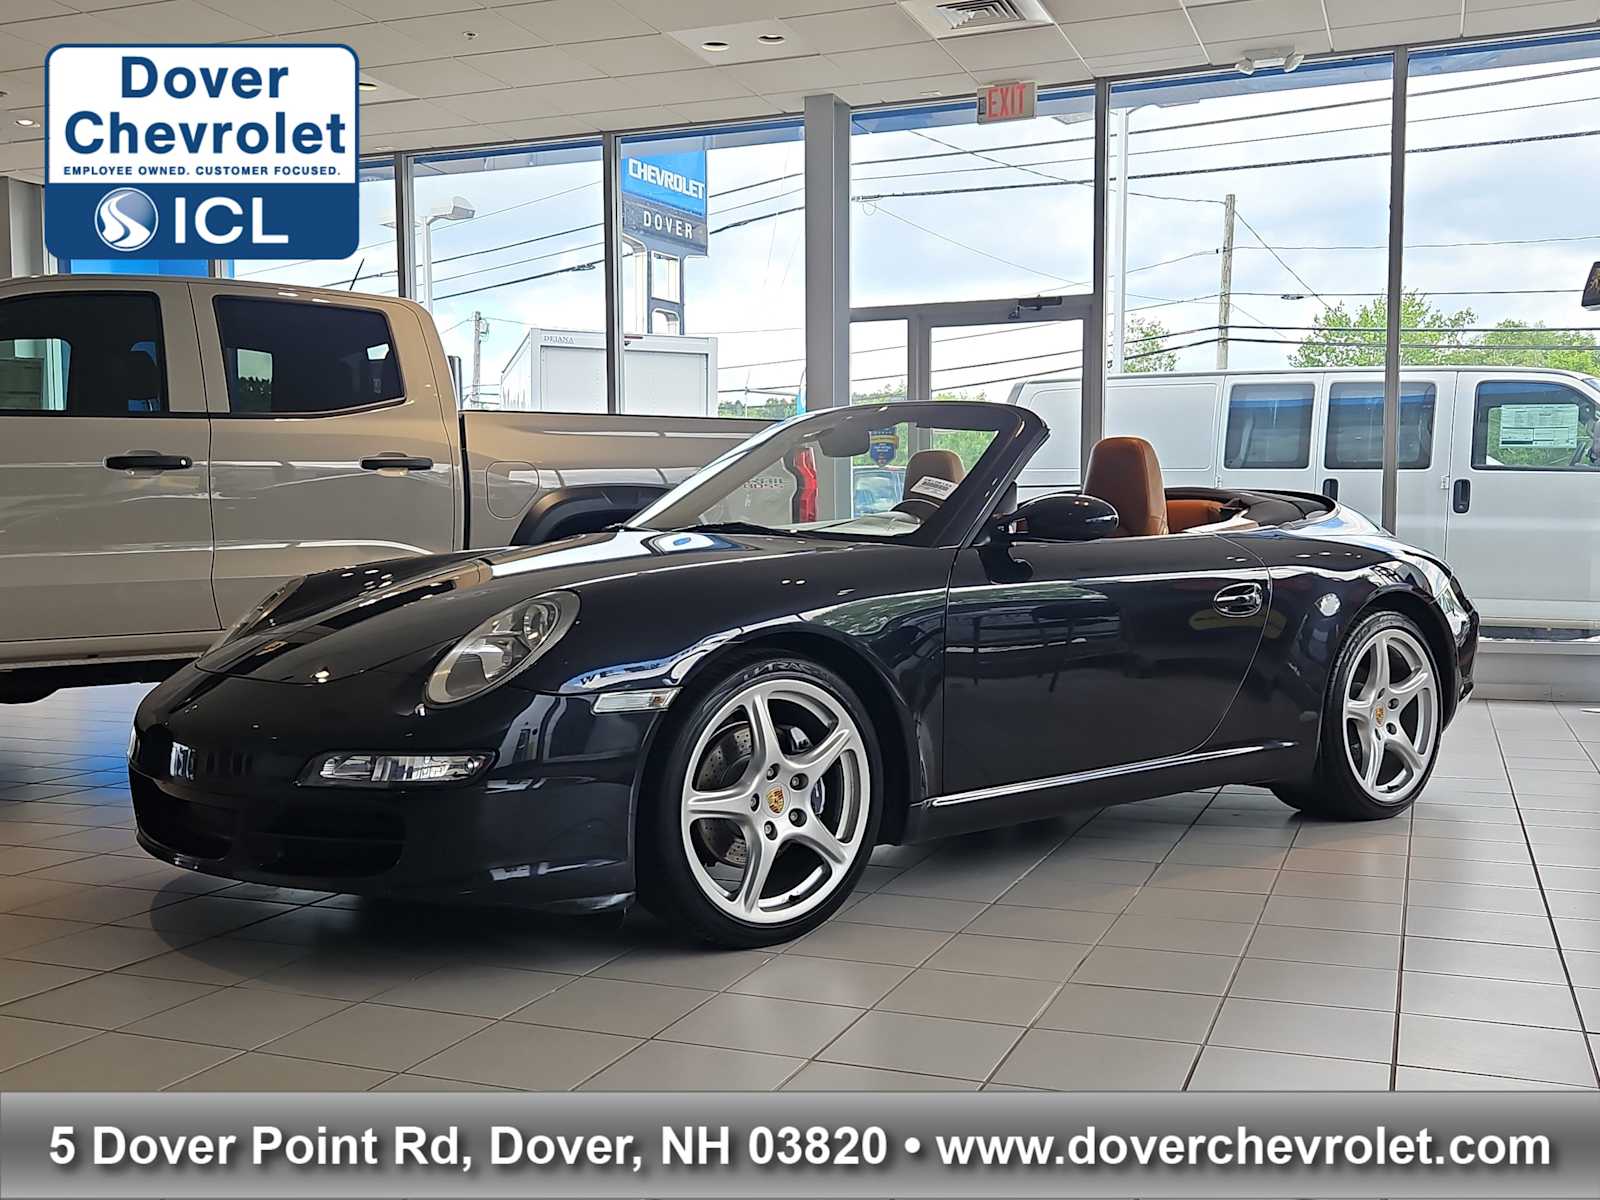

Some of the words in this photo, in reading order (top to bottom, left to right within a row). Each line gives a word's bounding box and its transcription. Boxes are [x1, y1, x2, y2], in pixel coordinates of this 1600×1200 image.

[987, 83, 1025, 118] EXIT
[628, 158, 705, 200] CHEVROLET
[643, 210, 693, 240] DOVER
